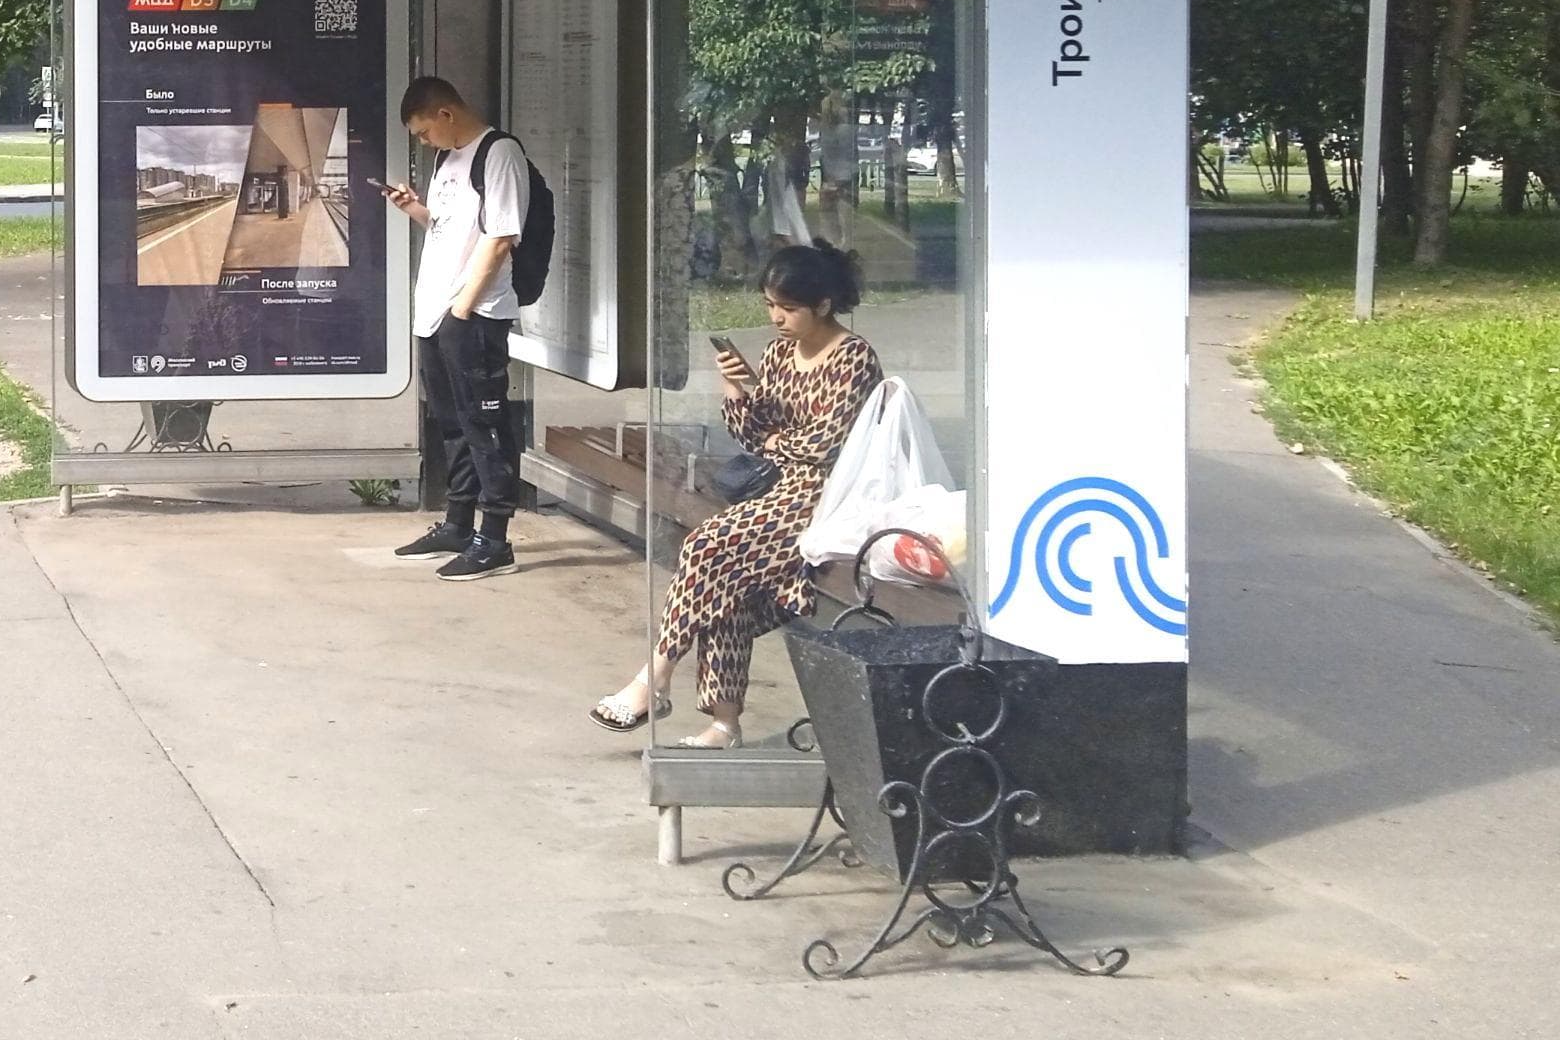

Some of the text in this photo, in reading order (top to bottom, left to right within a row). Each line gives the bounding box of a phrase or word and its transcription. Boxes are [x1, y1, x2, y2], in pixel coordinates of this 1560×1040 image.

[130, 22, 218, 34] Ваши новые
[129, 38, 272, 53] удобные маршруты
[145, 89, 175, 100] Было
[261, 279, 338, 289] После запуска
